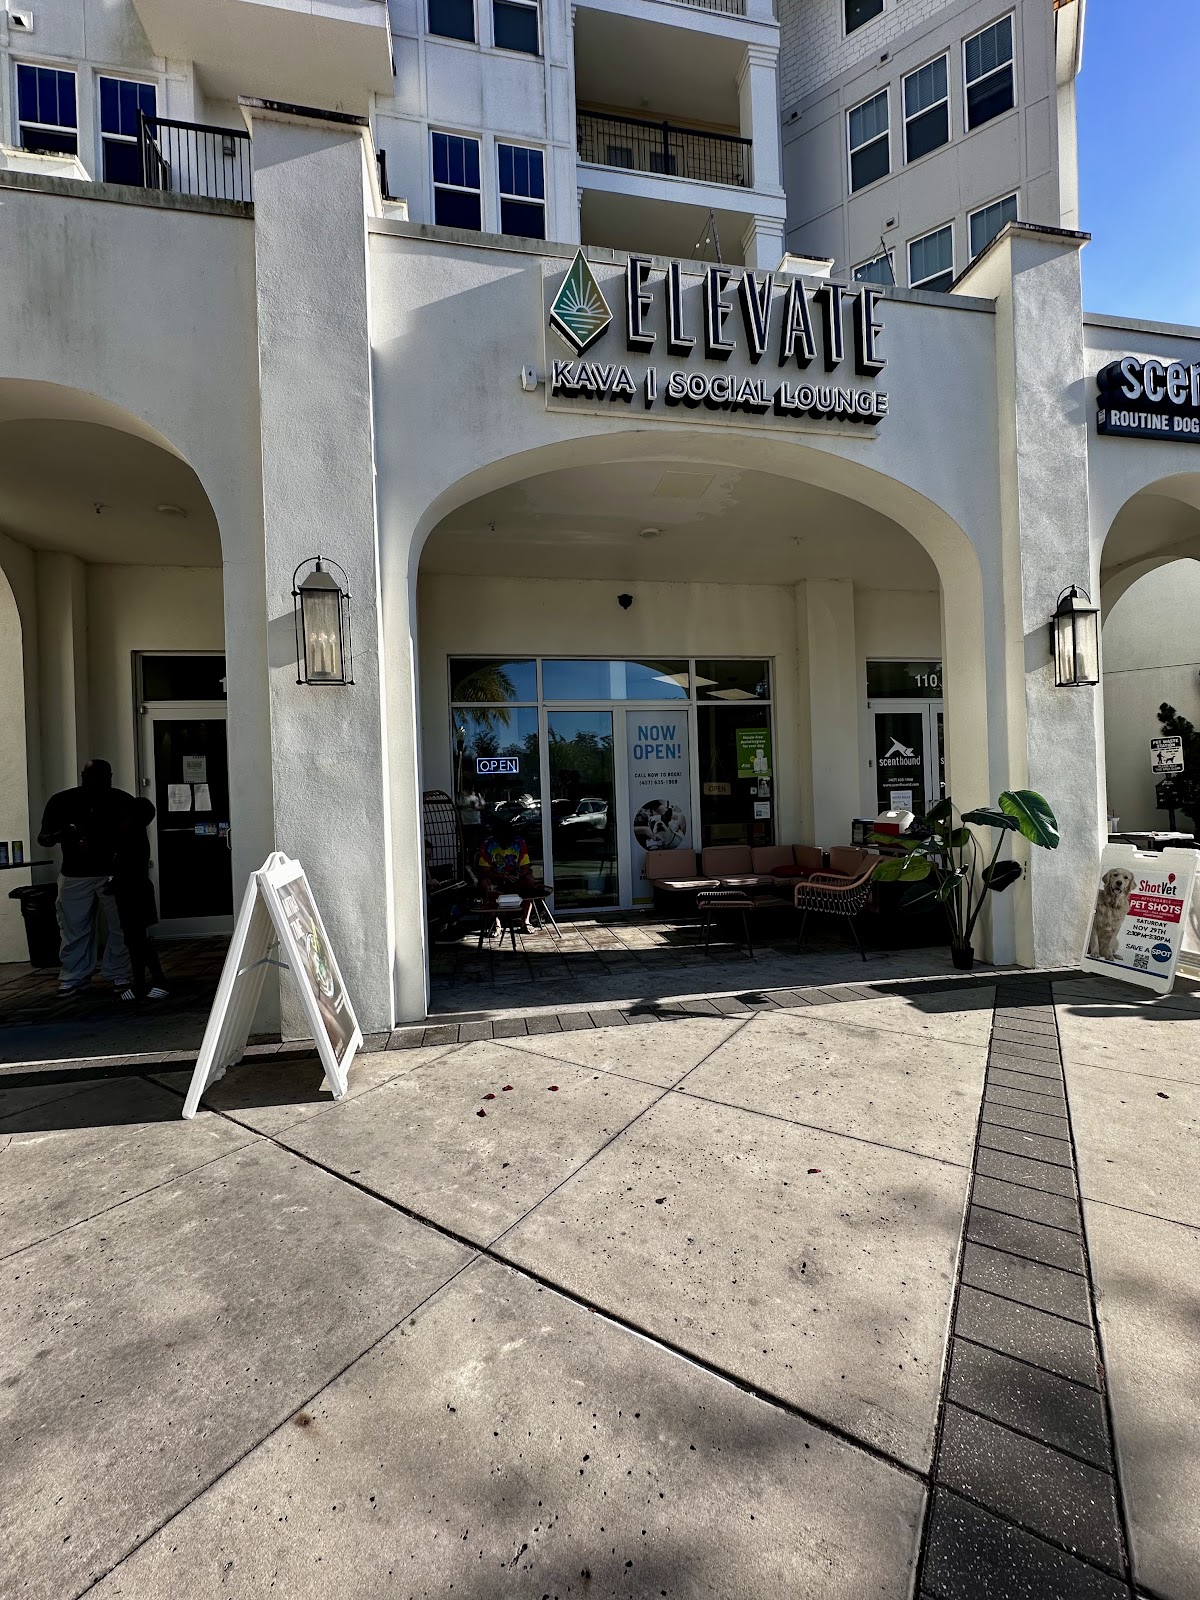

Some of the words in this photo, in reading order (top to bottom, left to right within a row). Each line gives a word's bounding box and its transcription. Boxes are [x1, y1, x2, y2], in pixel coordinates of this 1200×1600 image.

[625, 254, 888, 372] ELEVATE
[552, 359, 637, 396] KAVA
[668, 370, 774, 406] SOCIAL
[780, 380, 890, 416] LOUNGE
[1110, 409, 1169, 430] ROUTINE
[1173, 416, 1200, 433] DOG
[914, 674, 938, 688] 110
[638, 725, 676, 741] NOW
[633, 743, 682, 760] OPEN!
[479, 759, 517, 772] OPEN
[879, 755, 921, 767] scenthound
[708, 785, 727, 793] OPEN
[1138, 879, 1178, 896] ShotVet
[1130, 899, 1147, 909] PET
[1147, 902, 1182, 915] SHOTS
[1140, 896, 1172, 904] AFFORDABLE
[1132, 924, 1149, 932] NOV
[1136, 918, 1168, 928] SATURDAY
[1125, 943, 1144, 952] SAVE
[1151, 948, 1172, 958] SPOT
